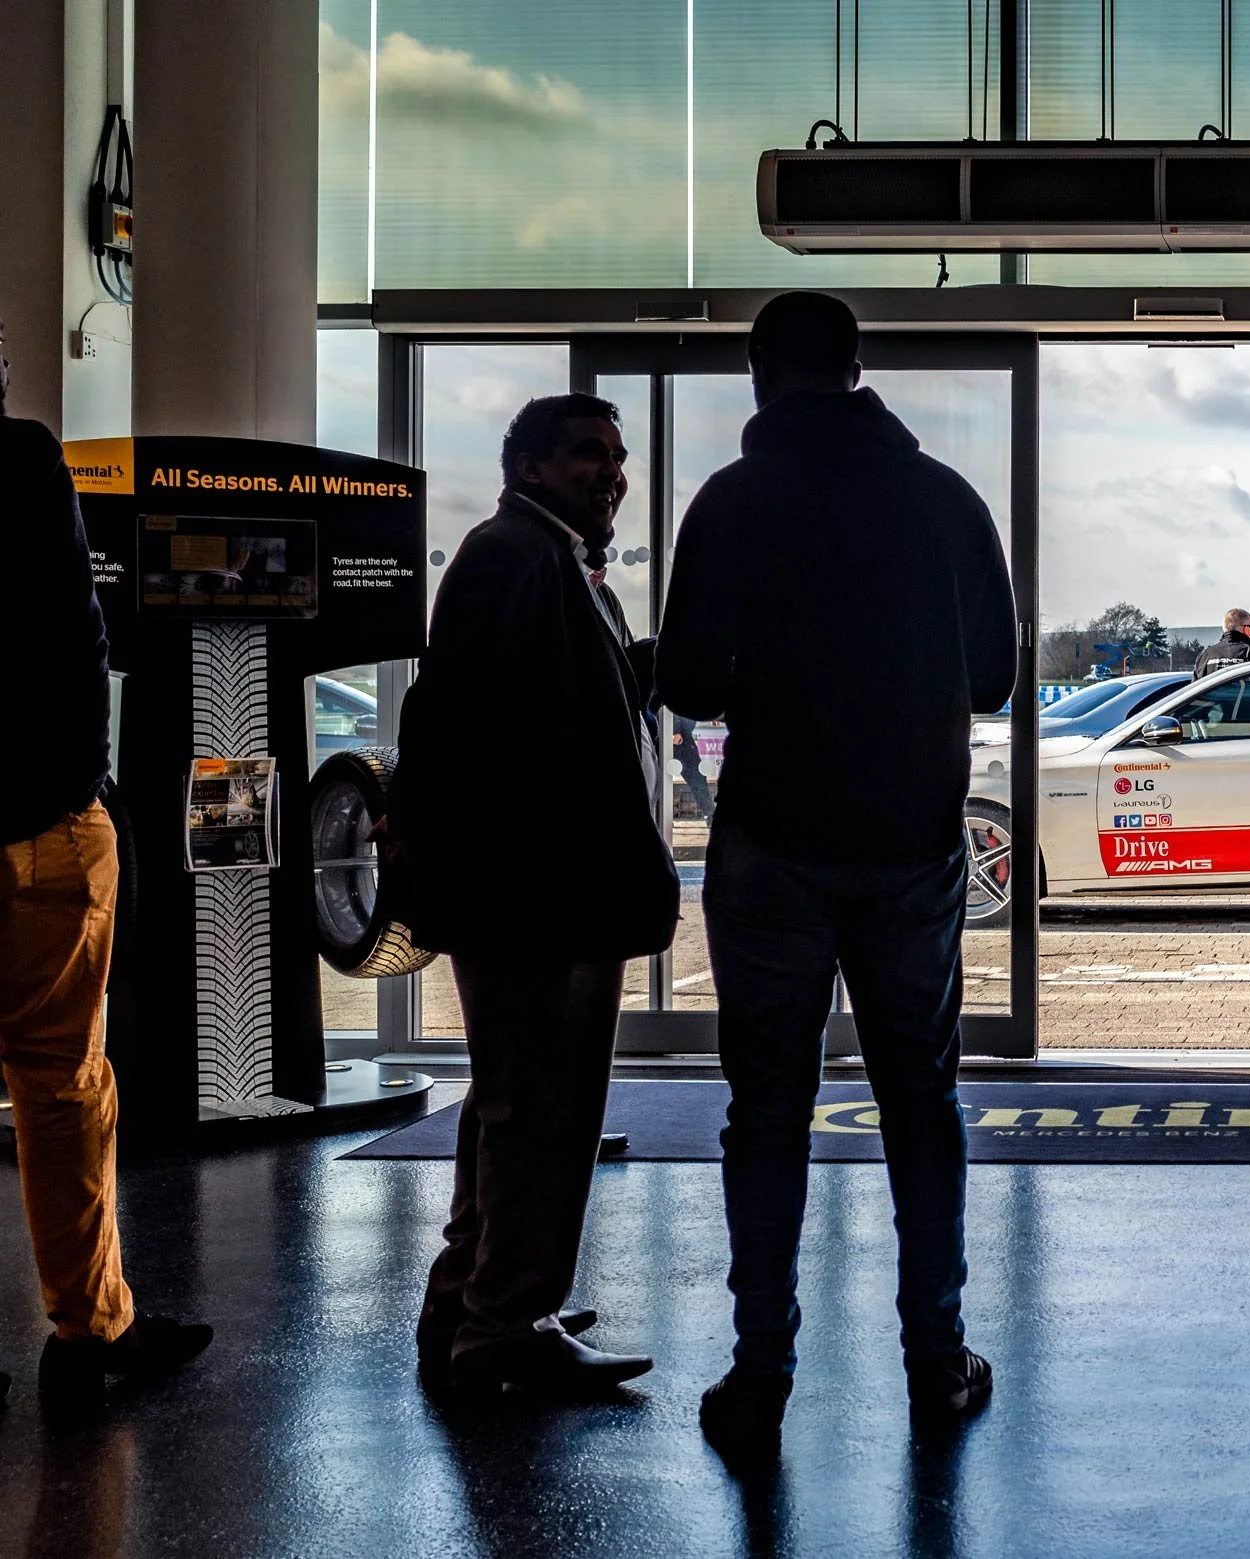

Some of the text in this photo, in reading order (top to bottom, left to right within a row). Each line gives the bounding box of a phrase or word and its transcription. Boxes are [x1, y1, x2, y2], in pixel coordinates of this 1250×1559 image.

[151, 468, 413, 498] All Seasons. All Winners.
[104, 562, 125, 572] safe,
[332, 557, 398, 567] Tyres are the only
[332, 569, 414, 578] contact patch with the
[333, 579, 394, 588] road, fit the best.
[1113, 763, 1162, 774] Continental
[1135, 779, 1155, 792] LG
[1113, 835, 1169, 858] Drive
[1146, 859, 1212, 872] AMG
